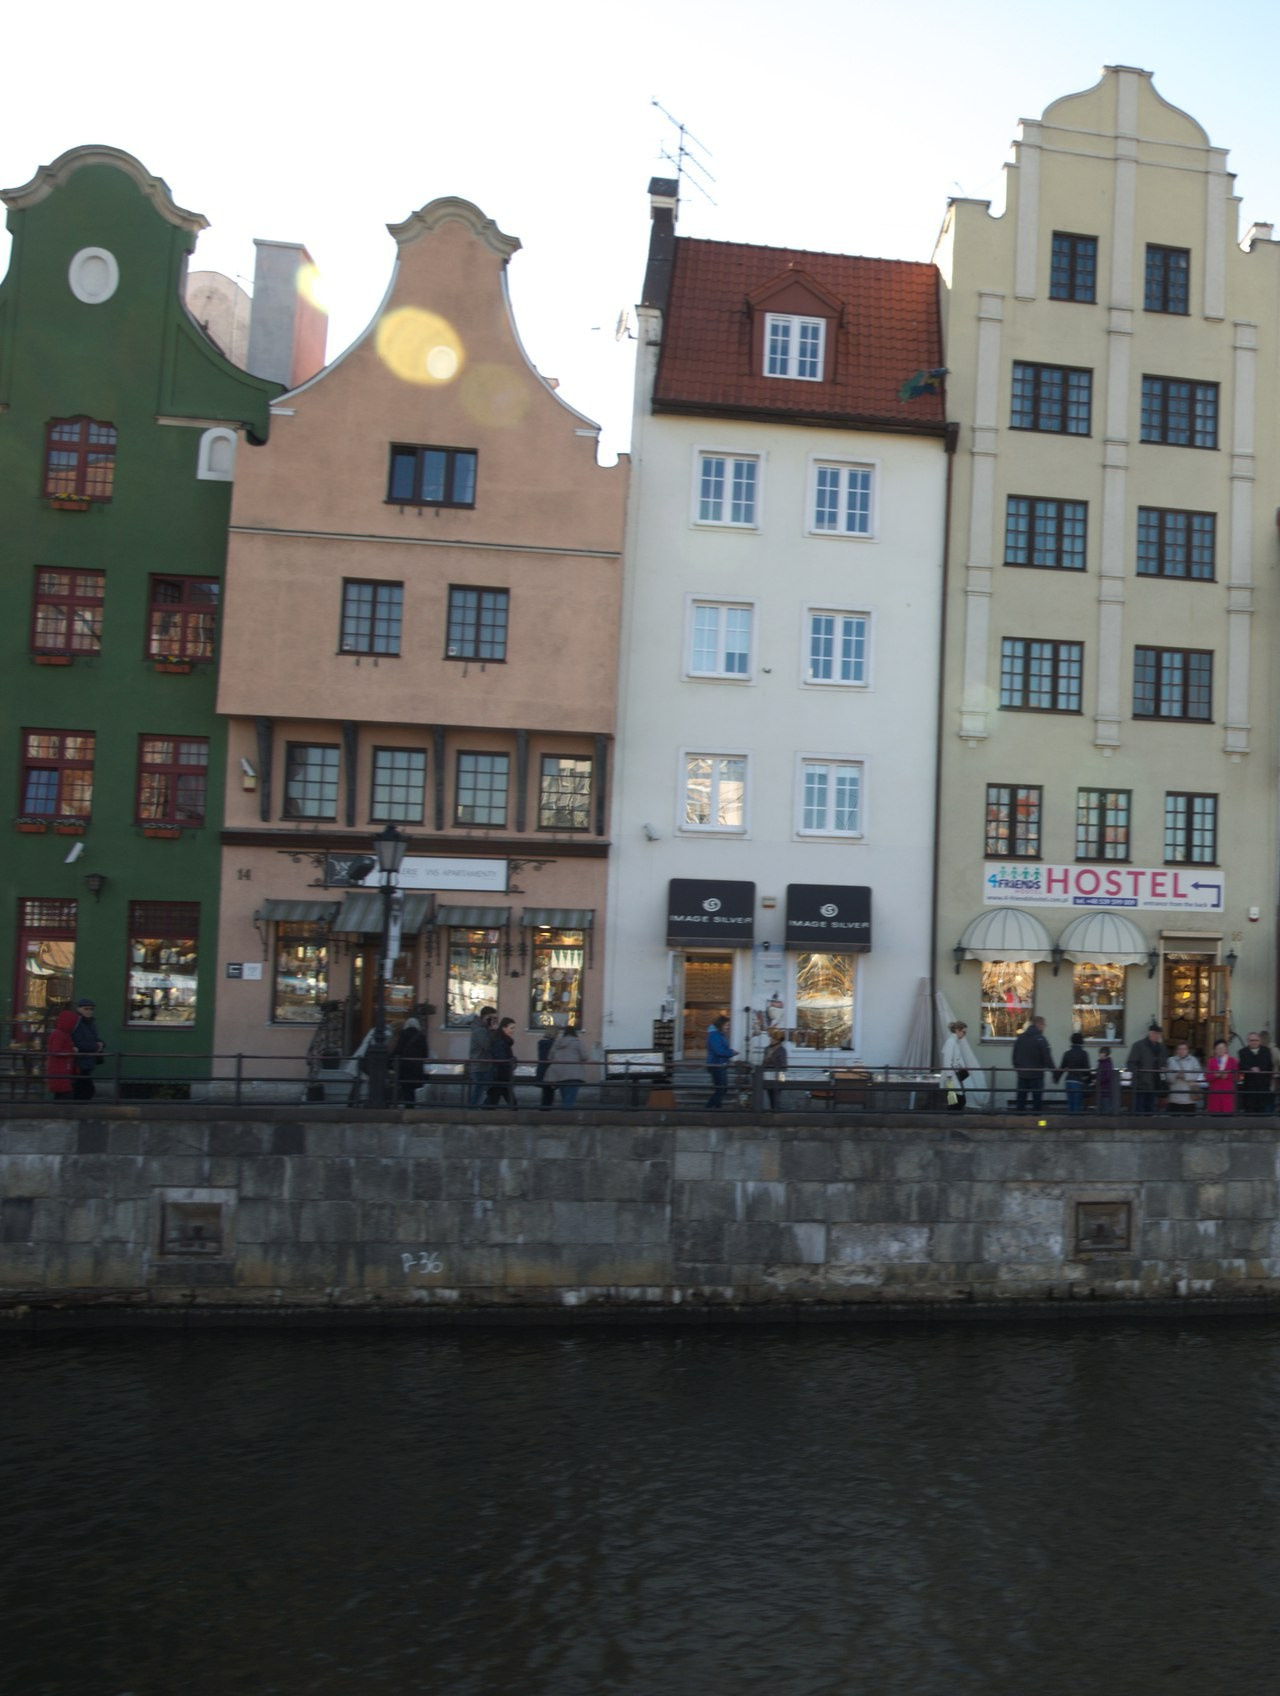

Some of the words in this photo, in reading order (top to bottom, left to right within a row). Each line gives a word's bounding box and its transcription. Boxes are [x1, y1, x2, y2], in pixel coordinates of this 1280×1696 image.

[237, 868, 251, 880] 14
[1046, 867, 1188, 899] HOSTEL
[670, 914, 709, 923] IMAGE
[713, 915, 753, 924] SILVER
[788, 919, 827, 928] IMAGE
[831, 921, 870, 929] SILVER
